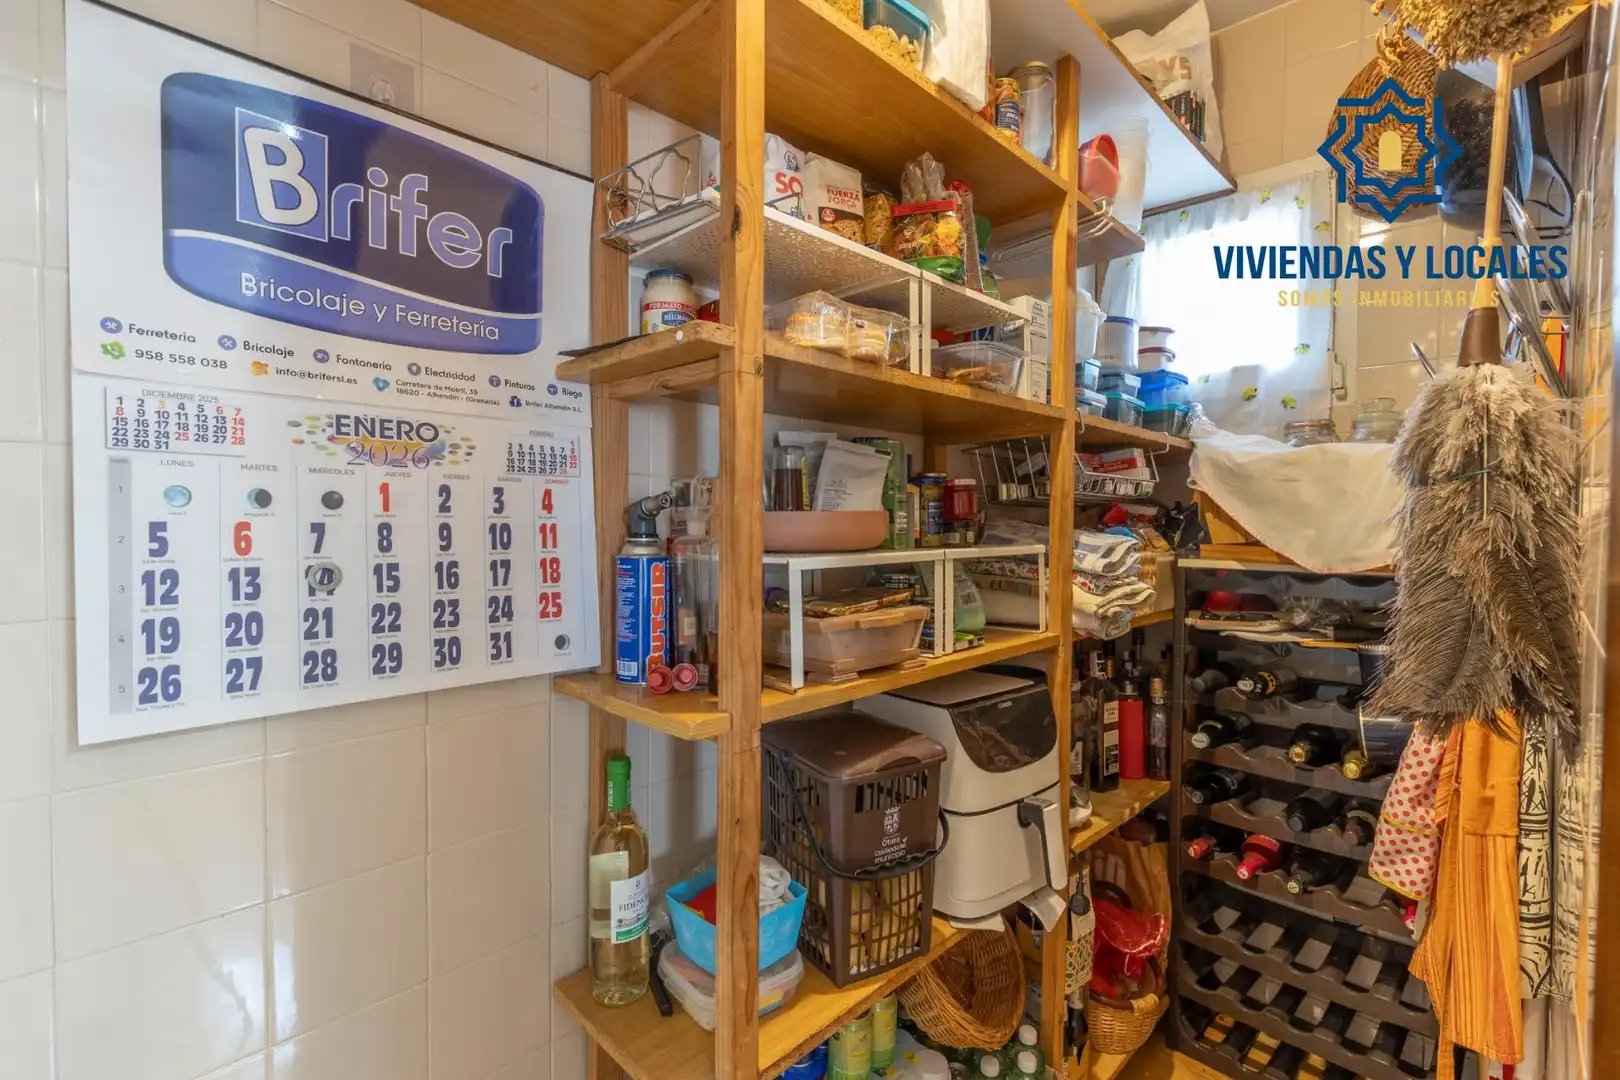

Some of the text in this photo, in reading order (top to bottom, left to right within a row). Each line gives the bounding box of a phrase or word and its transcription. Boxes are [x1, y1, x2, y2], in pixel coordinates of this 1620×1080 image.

[244, 126, 512, 278] Brifer
[827, 188, 859, 200] FUERZA
[241, 273, 500, 340] Bricolaje y Ferretería
[135, 349, 228, 369] 958 558 038
[244, 341, 295, 357] Bricolaje
[425, 367, 476, 382] Electricidad
[504, 379, 535, 391] Pinturas
[562, 388, 583, 398] Riego
[276, 367, 358, 385] info@brifersl.es
[142, 389, 195, 400] DICIEMBRE
[396, 380, 431, 389] Carretera
[396, 388, 419, 396] 18620
[116, 396, 123, 405] 1
[137, 399, 144, 407] 2
[178, 402, 185, 411] 4
[198, 404, 204, 413] 5
[216, 406, 223, 414] 6
[234, 408, 241, 416] 7
[113, 417, 244, 435] 15 16 17 18 19 20 21
[116, 407, 244, 426] 8 9 10 11 12 13 14
[112, 427, 245, 445] 22 23 24 25 26 27 28
[335, 415, 439, 442] ENERO
[112, 438, 169, 449] 29 30 31
[347, 440, 429, 469] 2026
[241, 464, 278, 472] MARTES
[379, 482, 390, 512] 1
[439, 484, 451, 513] 2
[493, 487, 504, 514] 3
[542, 488, 553, 514] 4
[148, 521, 169, 558] 5
[233, 521, 253, 556] 6
[310, 522, 326, 554] 7
[378, 522, 392, 553] 8
[438, 522, 452, 551] 9
[488, 523, 512, 550] 10
[539, 523, 557, 549] 11
[141, 569, 179, 606] 12
[228, 567, 261, 601] 13
[374, 562, 400, 593] 15
[434, 560, 459, 590] 16
[490, 559, 511, 586] 17
[540, 557, 561, 584] 18
[141, 616, 180, 655] 19
[225, 611, 263, 647] 20
[303, 607, 333, 640] 21
[371, 602, 401, 634] 22
[433, 599, 460, 628] 23
[488, 595, 514, 623] 24
[539, 592, 563, 619] 25
[138, 664, 181, 705] 26
[226, 656, 263, 694] 27
[303, 649, 337, 684] 28
[372, 642, 402, 675] 29
[434, 636, 461, 668] 30
[490, 631, 513, 661] 31
[875, 850, 906, 864] municipio
